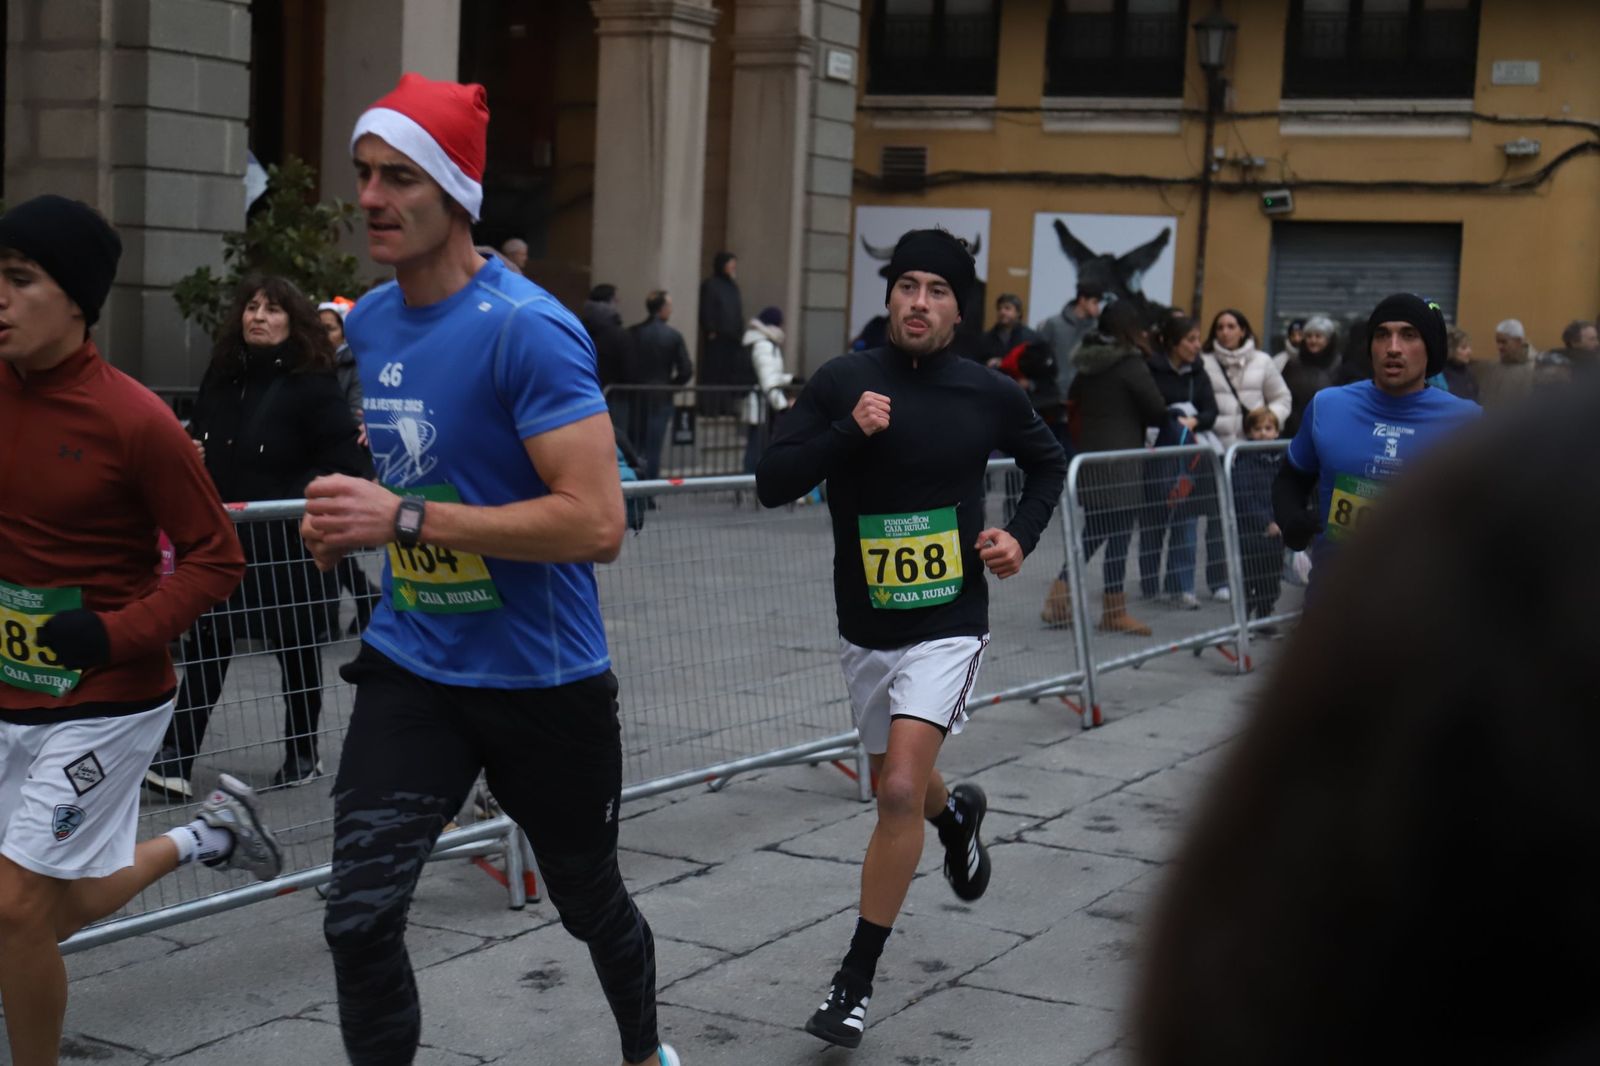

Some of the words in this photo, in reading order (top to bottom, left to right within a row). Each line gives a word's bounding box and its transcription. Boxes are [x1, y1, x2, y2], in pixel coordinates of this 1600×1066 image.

[378, 362, 404, 387] 46
[885, 525, 903, 533] CAJA
[904, 522, 930, 532] RURAL
[868, 544, 947, 583] 768
[418, 589, 445, 605] CAJA
[446, 588, 493, 604] RURAL
[893, 592, 920, 603] CAJA
[922, 585, 958, 600] RURAL
[0, 620, 64, 666] 85
[3, 665, 31, 682] CAJA
